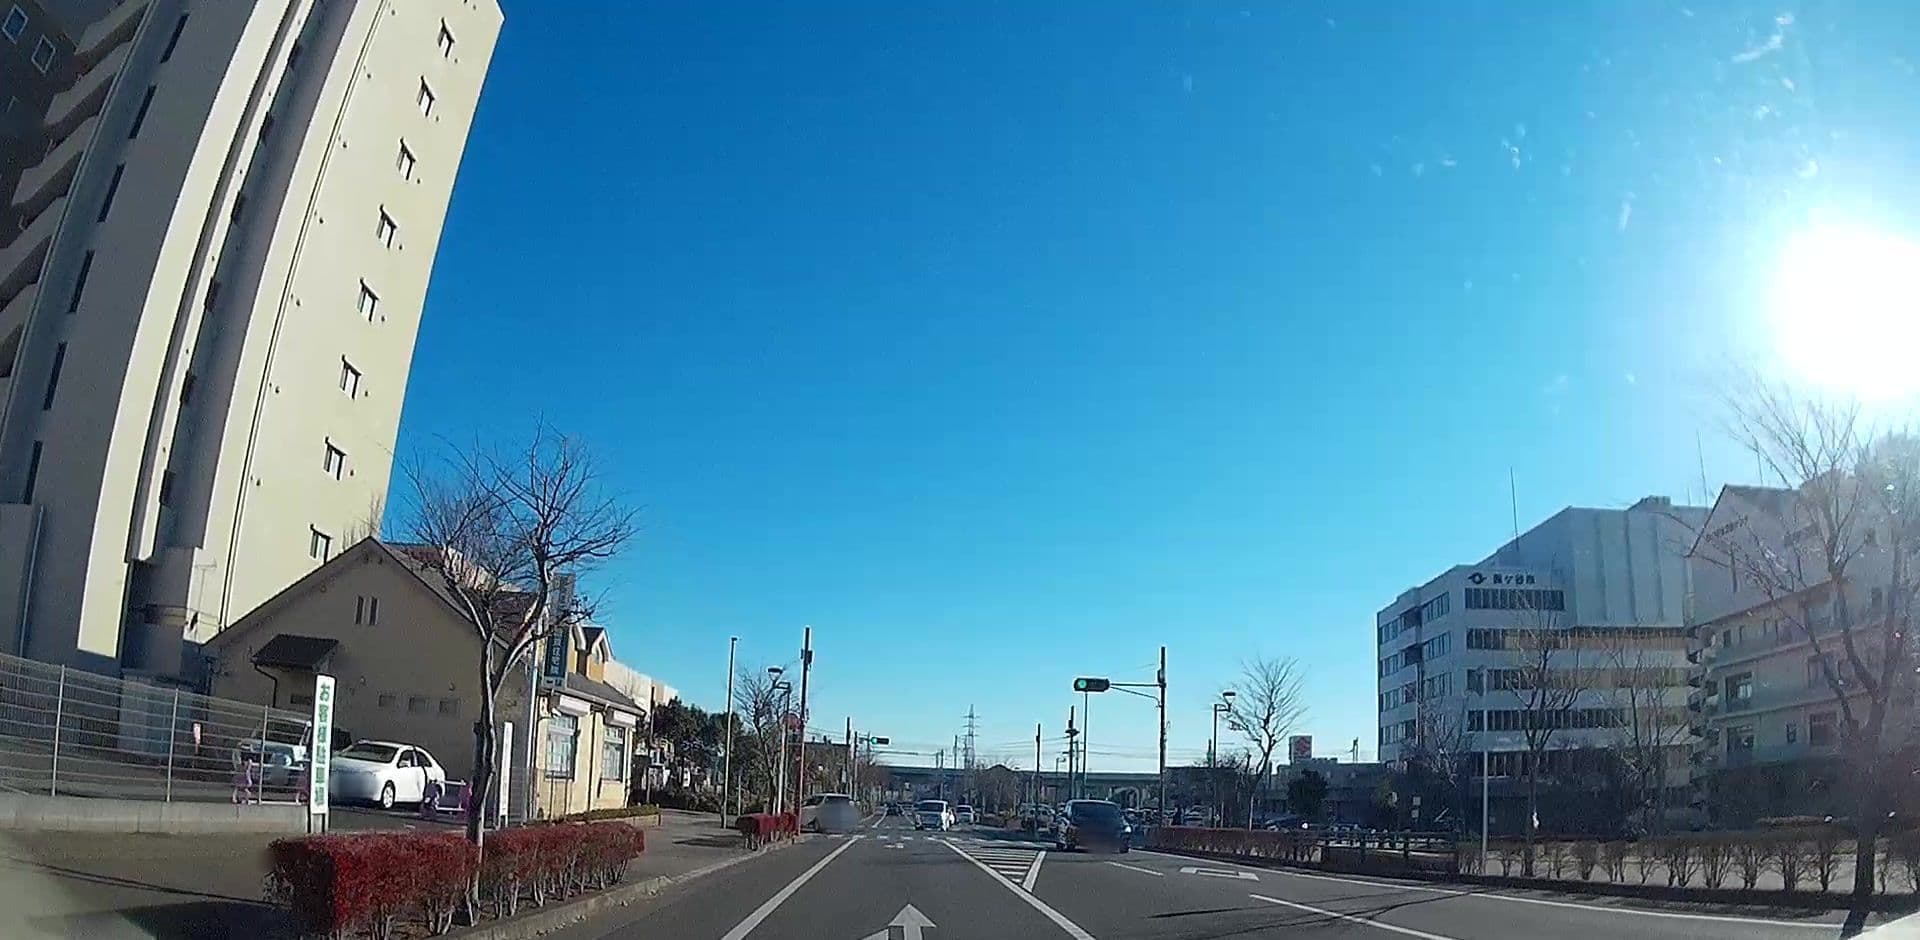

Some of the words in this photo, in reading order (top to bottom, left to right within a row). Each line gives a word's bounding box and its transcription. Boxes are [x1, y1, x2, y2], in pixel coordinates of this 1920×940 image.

[314, 681, 331, 806] お客様駐車場
